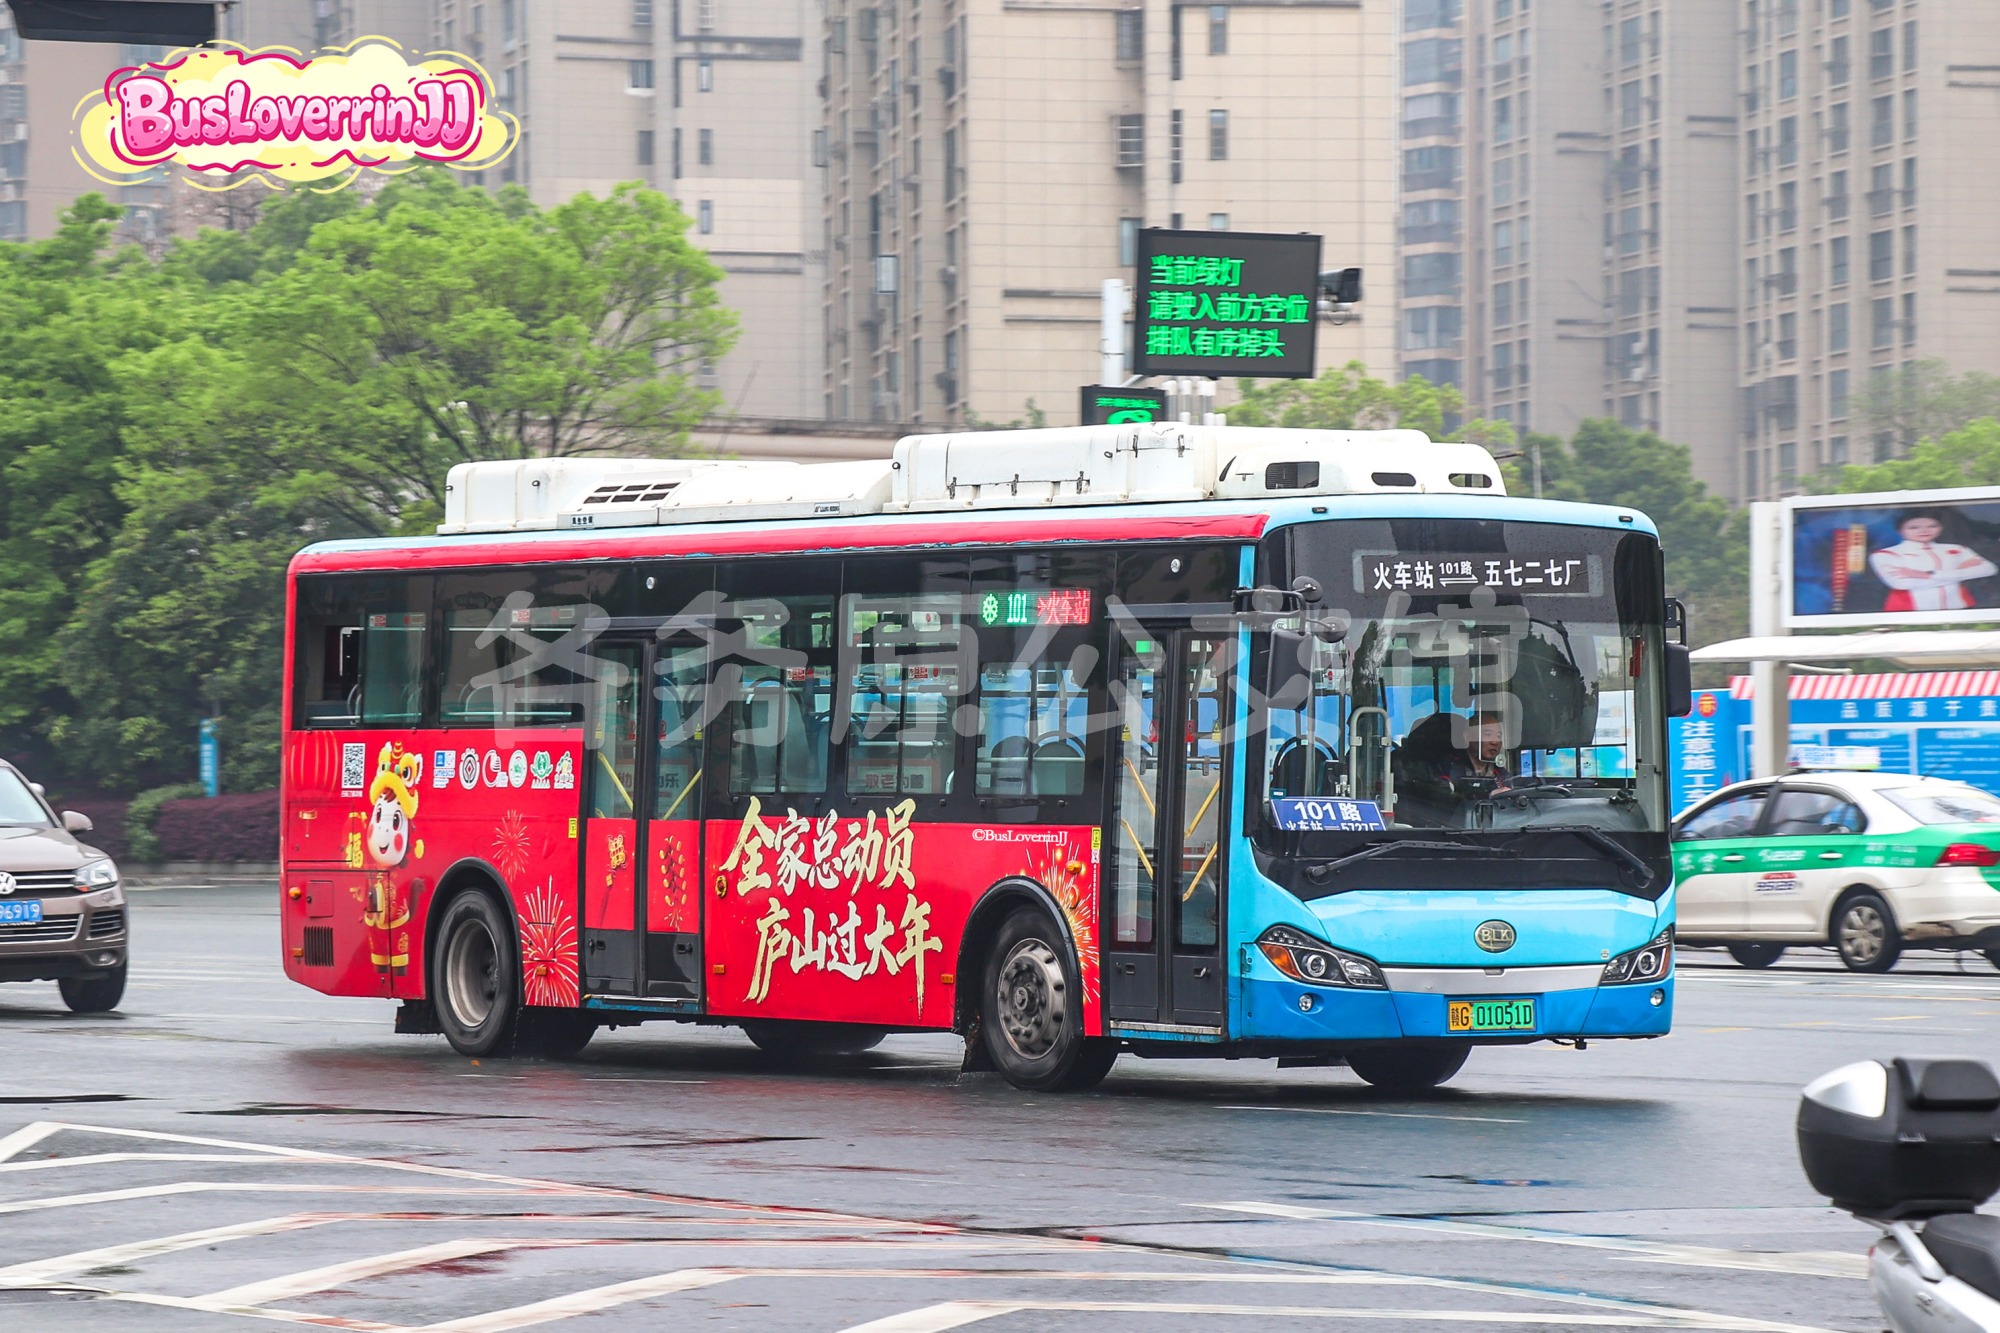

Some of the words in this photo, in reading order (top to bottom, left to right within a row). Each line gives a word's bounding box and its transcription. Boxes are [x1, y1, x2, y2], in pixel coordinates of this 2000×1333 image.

[1150, 255, 1245, 287] 当前绿灯
[1147, 290, 1310, 323] 请驶入前方空位
[1146, 325, 1286, 358] 排队有序掉头
[1373, 561, 1434, 590] 火车站
[1438, 560, 1473, 576] 101路
[1484, 559, 1582, 587] 五七二七厂
[1006, 593, 1028, 623] 101
[1044, 589, 1091, 625] 火车站
[1294, 801, 1363, 822] 101路
[719, 796, 916, 896] 全家总动员
[1481, 928, 1511, 941] BLK
[742, 893, 943, 1020] 庐山过大年
